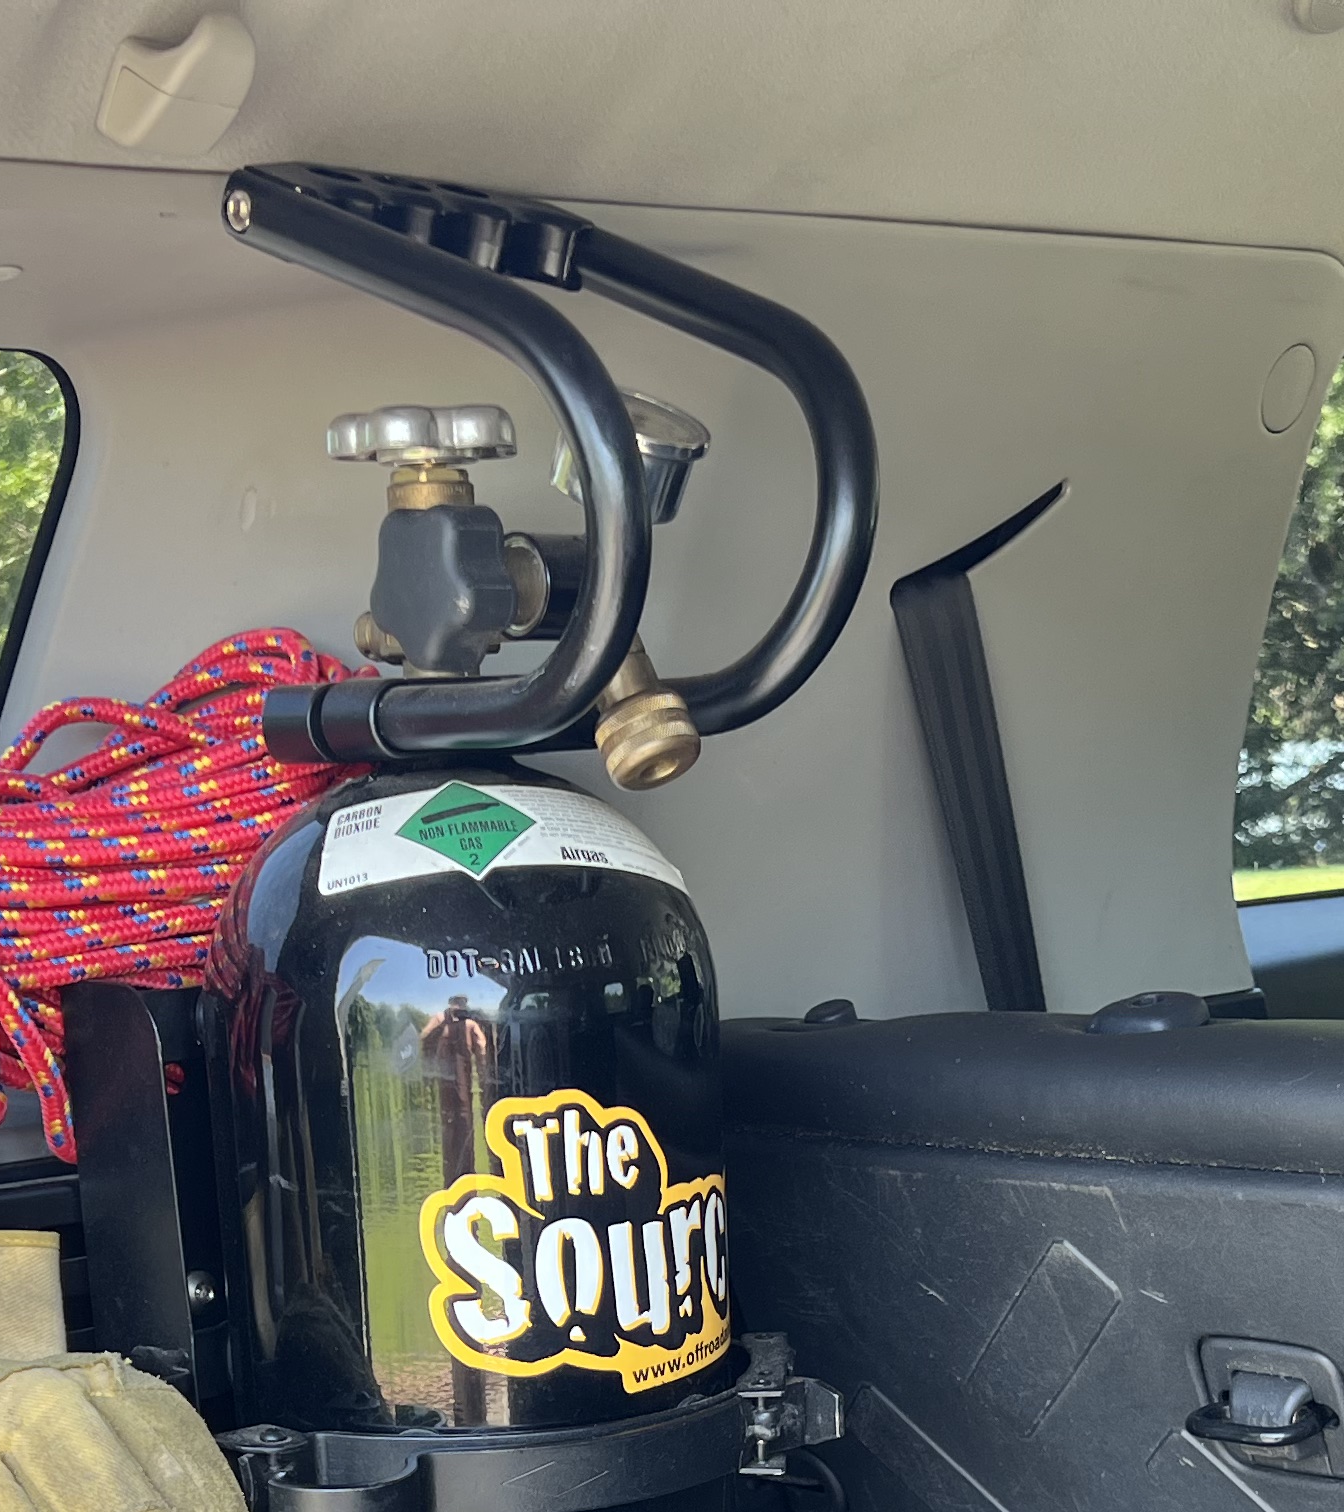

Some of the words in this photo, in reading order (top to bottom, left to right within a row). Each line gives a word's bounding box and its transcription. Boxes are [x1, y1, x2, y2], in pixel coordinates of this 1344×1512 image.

[337, 805, 382, 825] CARBON
[334, 817, 380, 839] DIOXIDE
[460, 837, 483, 851] GAS
[469, 853, 481, 866] 2
[560, 846, 608, 864] Airgas
[327, 872, 368, 890] UN1013
[513, 1109, 639, 1201] The
[444, 1193, 726, 1344] Sourc
